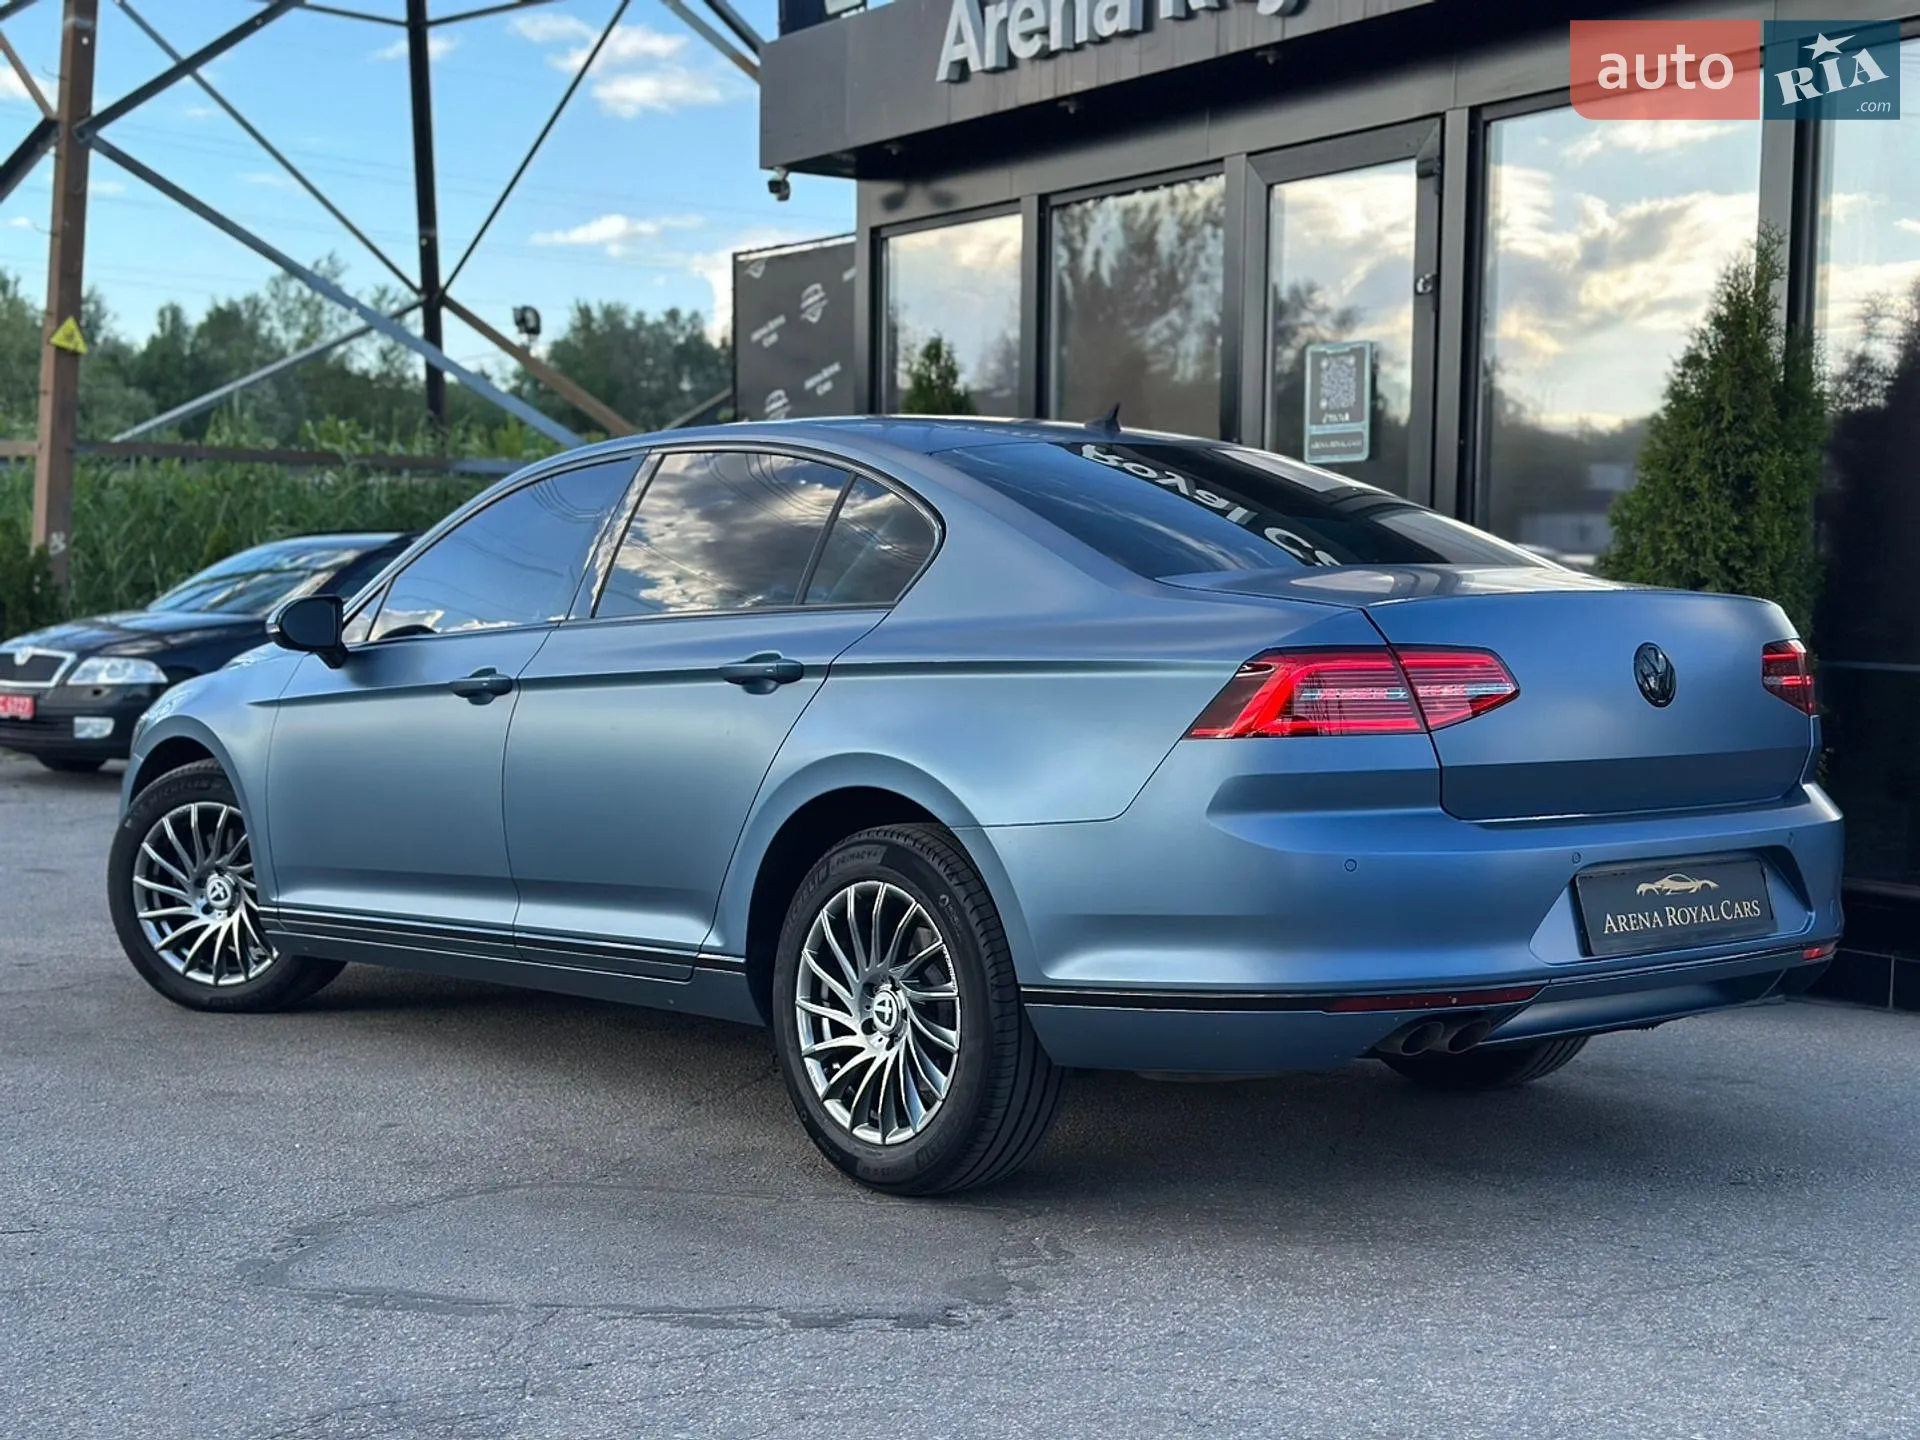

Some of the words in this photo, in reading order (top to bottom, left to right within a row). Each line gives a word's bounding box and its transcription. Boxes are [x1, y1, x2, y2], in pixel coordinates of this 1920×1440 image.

[936, 0, 1143, 82] Arena
[1603, 911, 1664, 935] ARENA
[1665, 905, 1720, 927] ROYAL
[1720, 899, 1761, 920] CARS
